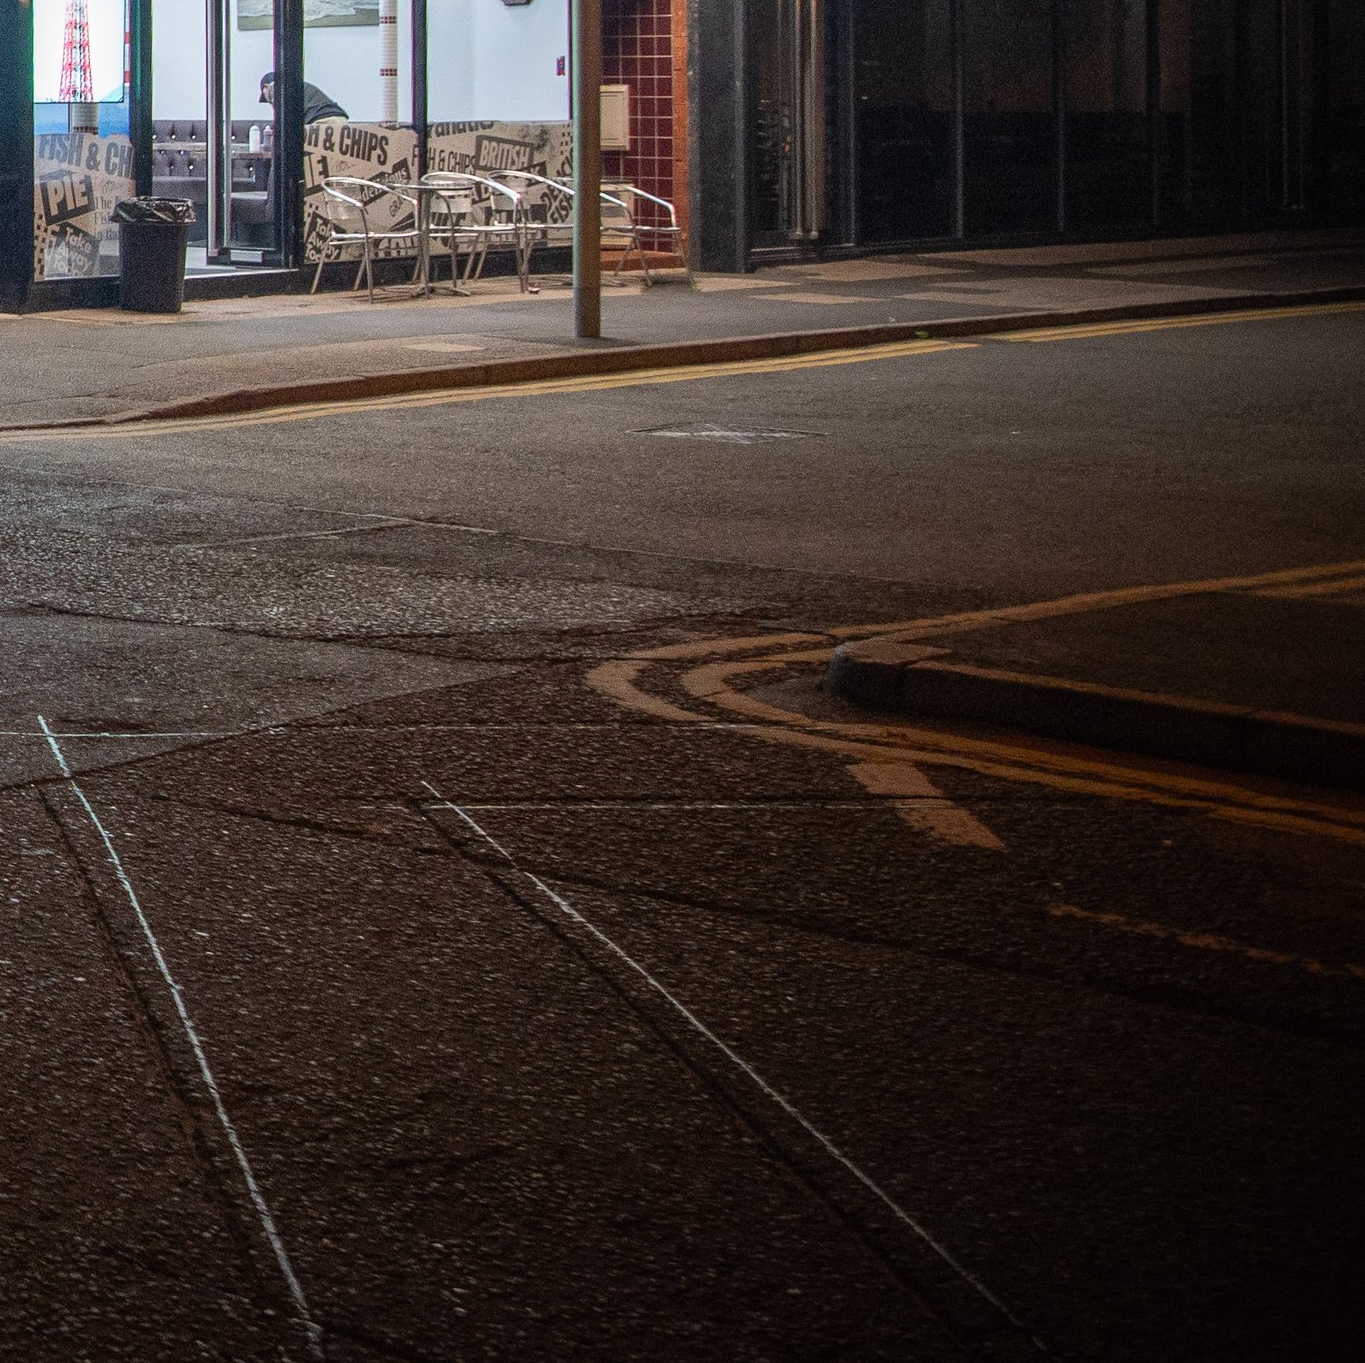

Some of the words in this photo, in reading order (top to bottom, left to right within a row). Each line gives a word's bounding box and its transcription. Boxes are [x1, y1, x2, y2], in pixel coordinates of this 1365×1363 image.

[85, 141, 101, 172] &
[323, 125, 336, 153] &
[338, 125, 389, 167] CHIPS
[438, 149, 446, 172] &
[479, 138, 532, 171] BRITISH
[46, 174, 89, 217] PIE
[64, 226, 93, 254] Take
